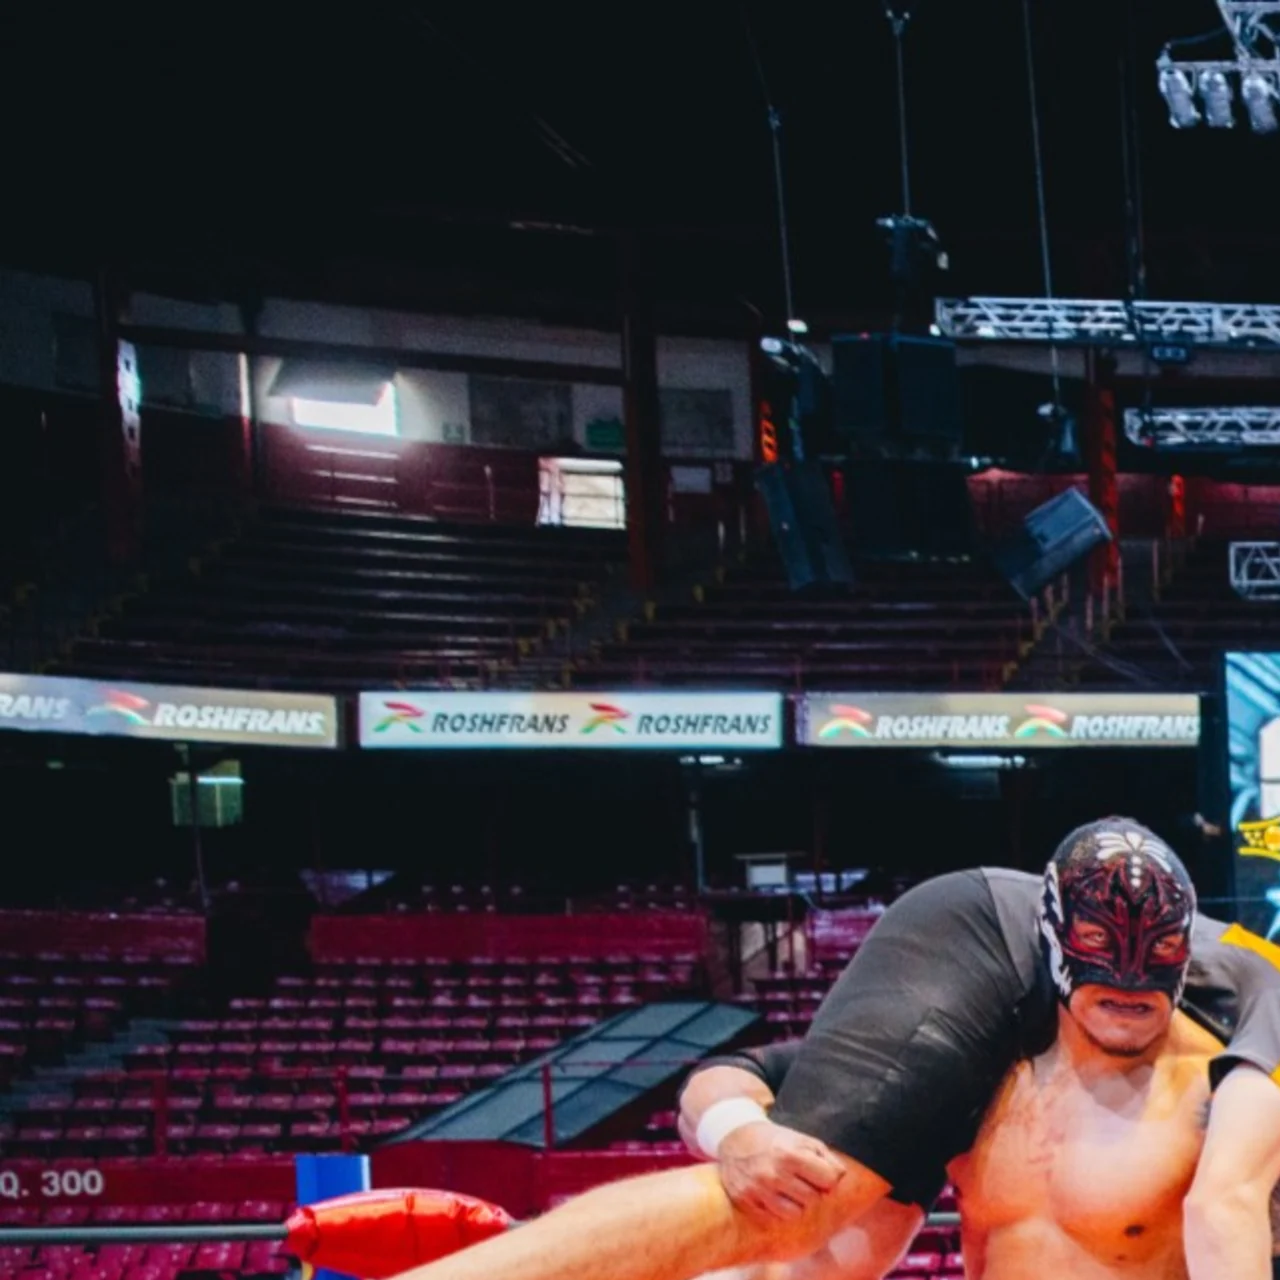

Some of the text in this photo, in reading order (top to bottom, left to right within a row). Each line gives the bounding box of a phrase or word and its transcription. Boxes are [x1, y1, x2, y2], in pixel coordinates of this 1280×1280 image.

[153, 702, 326, 735] ROSHFRANS
[431, 712, 570, 734] ROSHFRANS
[635, 713, 772, 735] ROSHFRANS
[874, 715, 1010, 739] ROSHFRANS
[1070, 715, 1199, 739] ROSHFRANS
[41, 1169, 104, 1197] 300
